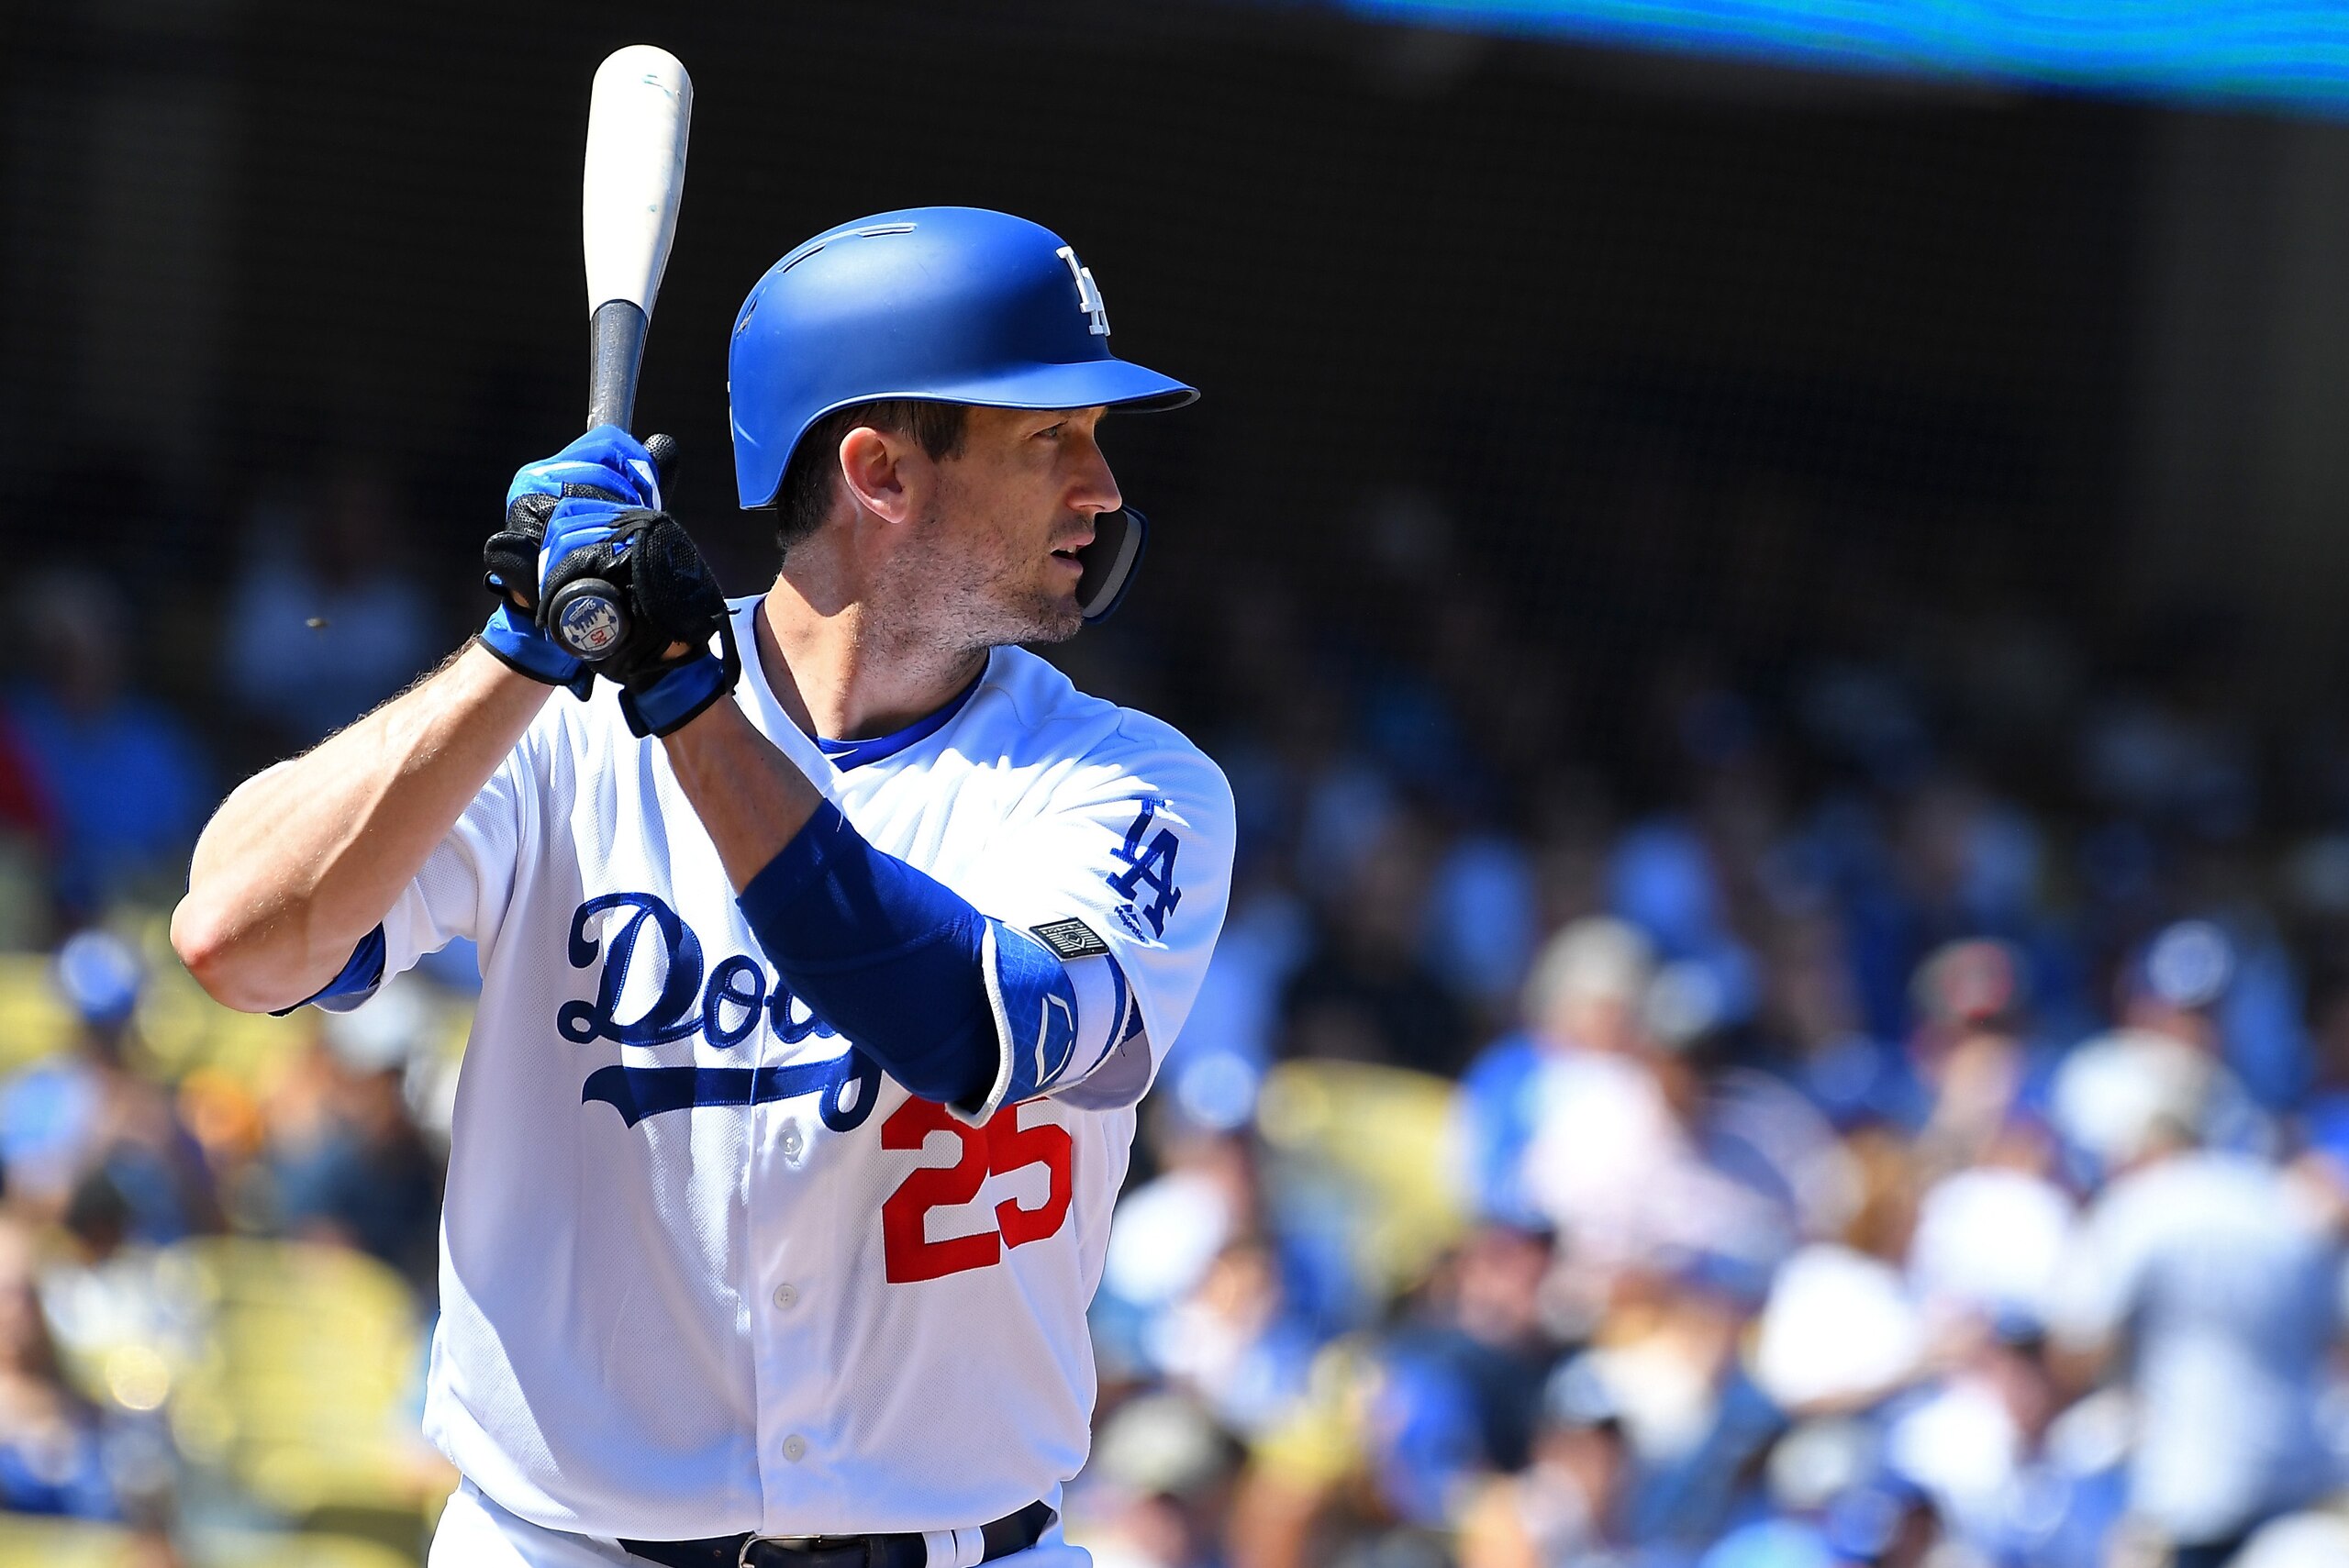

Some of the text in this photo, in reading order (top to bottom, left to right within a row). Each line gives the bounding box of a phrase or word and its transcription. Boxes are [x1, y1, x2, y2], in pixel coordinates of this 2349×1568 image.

[1055, 246, 1110, 336] LA
[591, 629, 607, 645] 25
[1106, 797, 1182, 939] LA
[1114, 906, 1146, 942] Majestic
[881, 1096, 1073, 1284] 25
